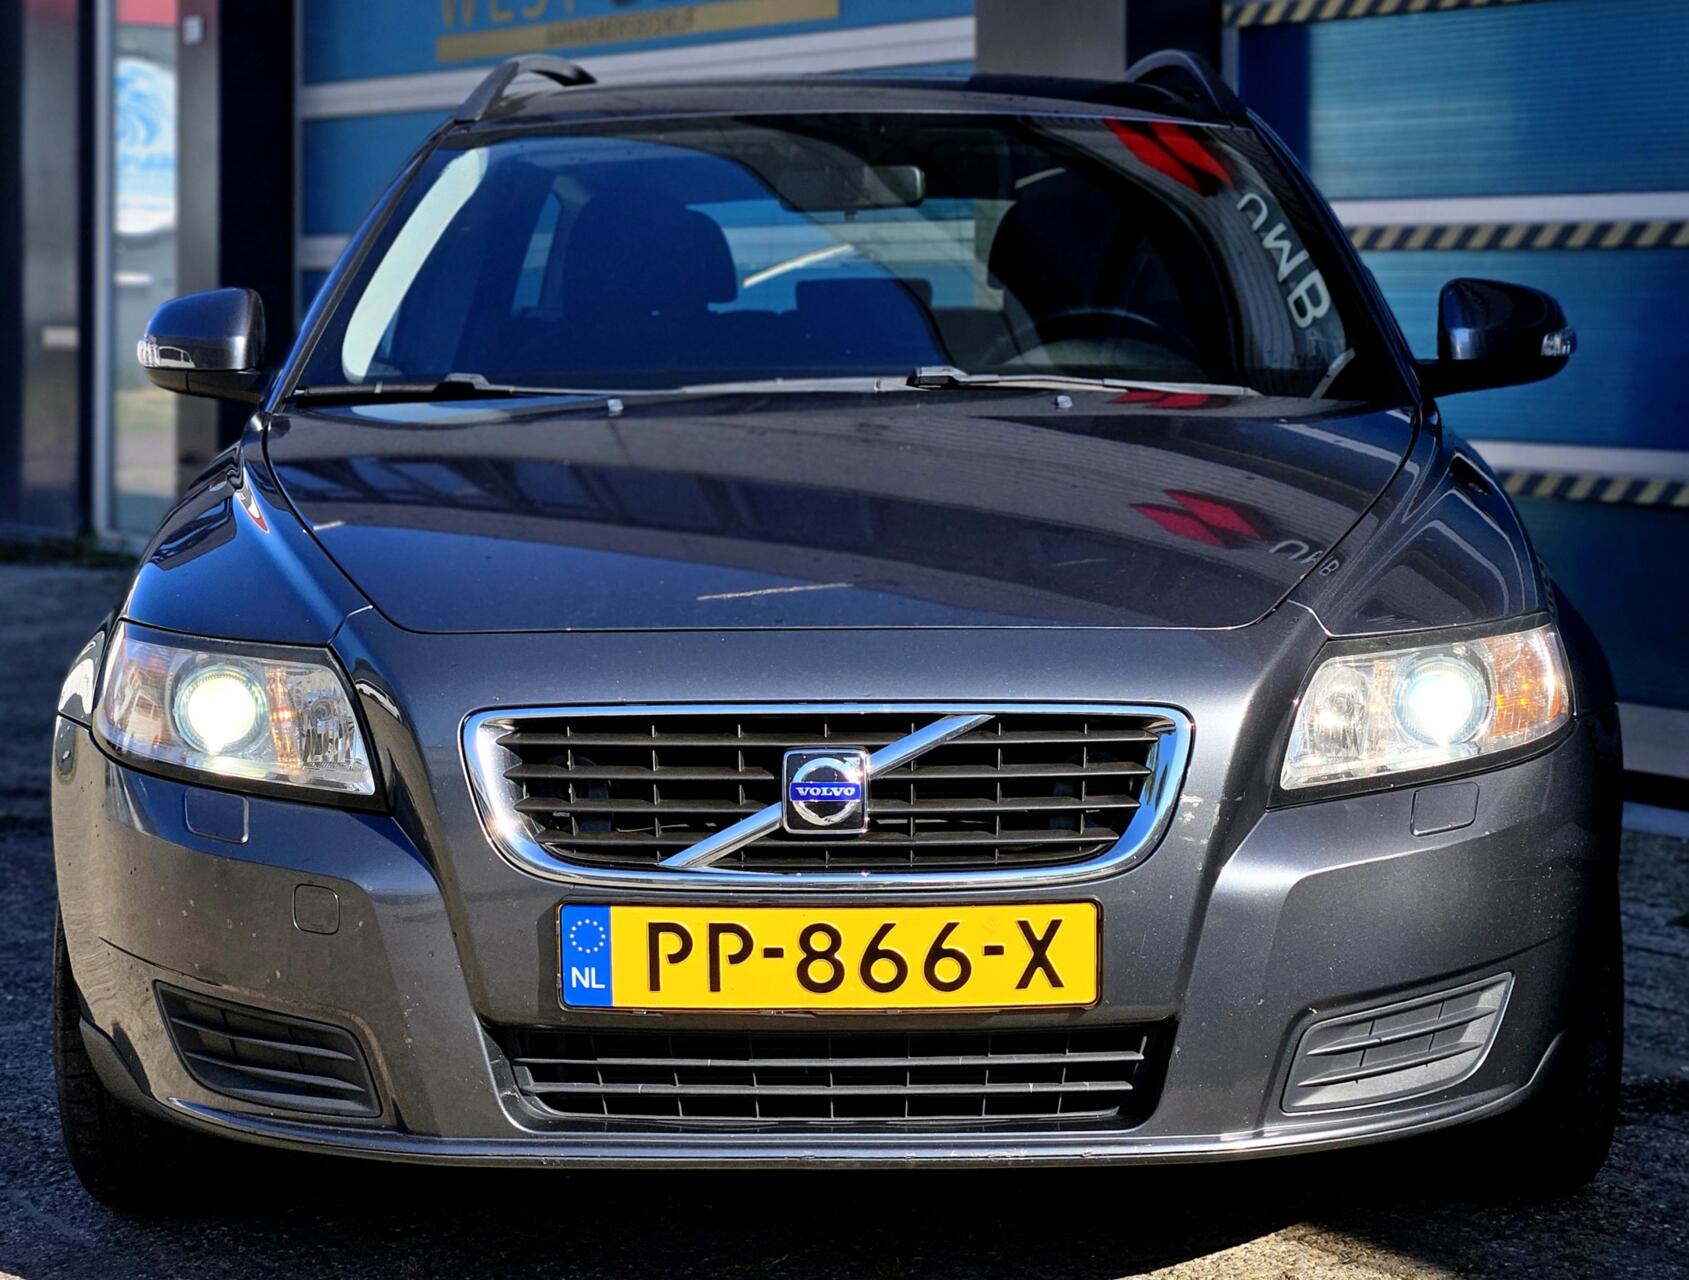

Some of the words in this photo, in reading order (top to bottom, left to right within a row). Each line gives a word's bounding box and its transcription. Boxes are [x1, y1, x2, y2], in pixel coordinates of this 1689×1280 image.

[795, 786, 856, 797] VOLVO
[646, 918, 1065, 994] PP-866-X
[570, 967, 606, 989] NL
